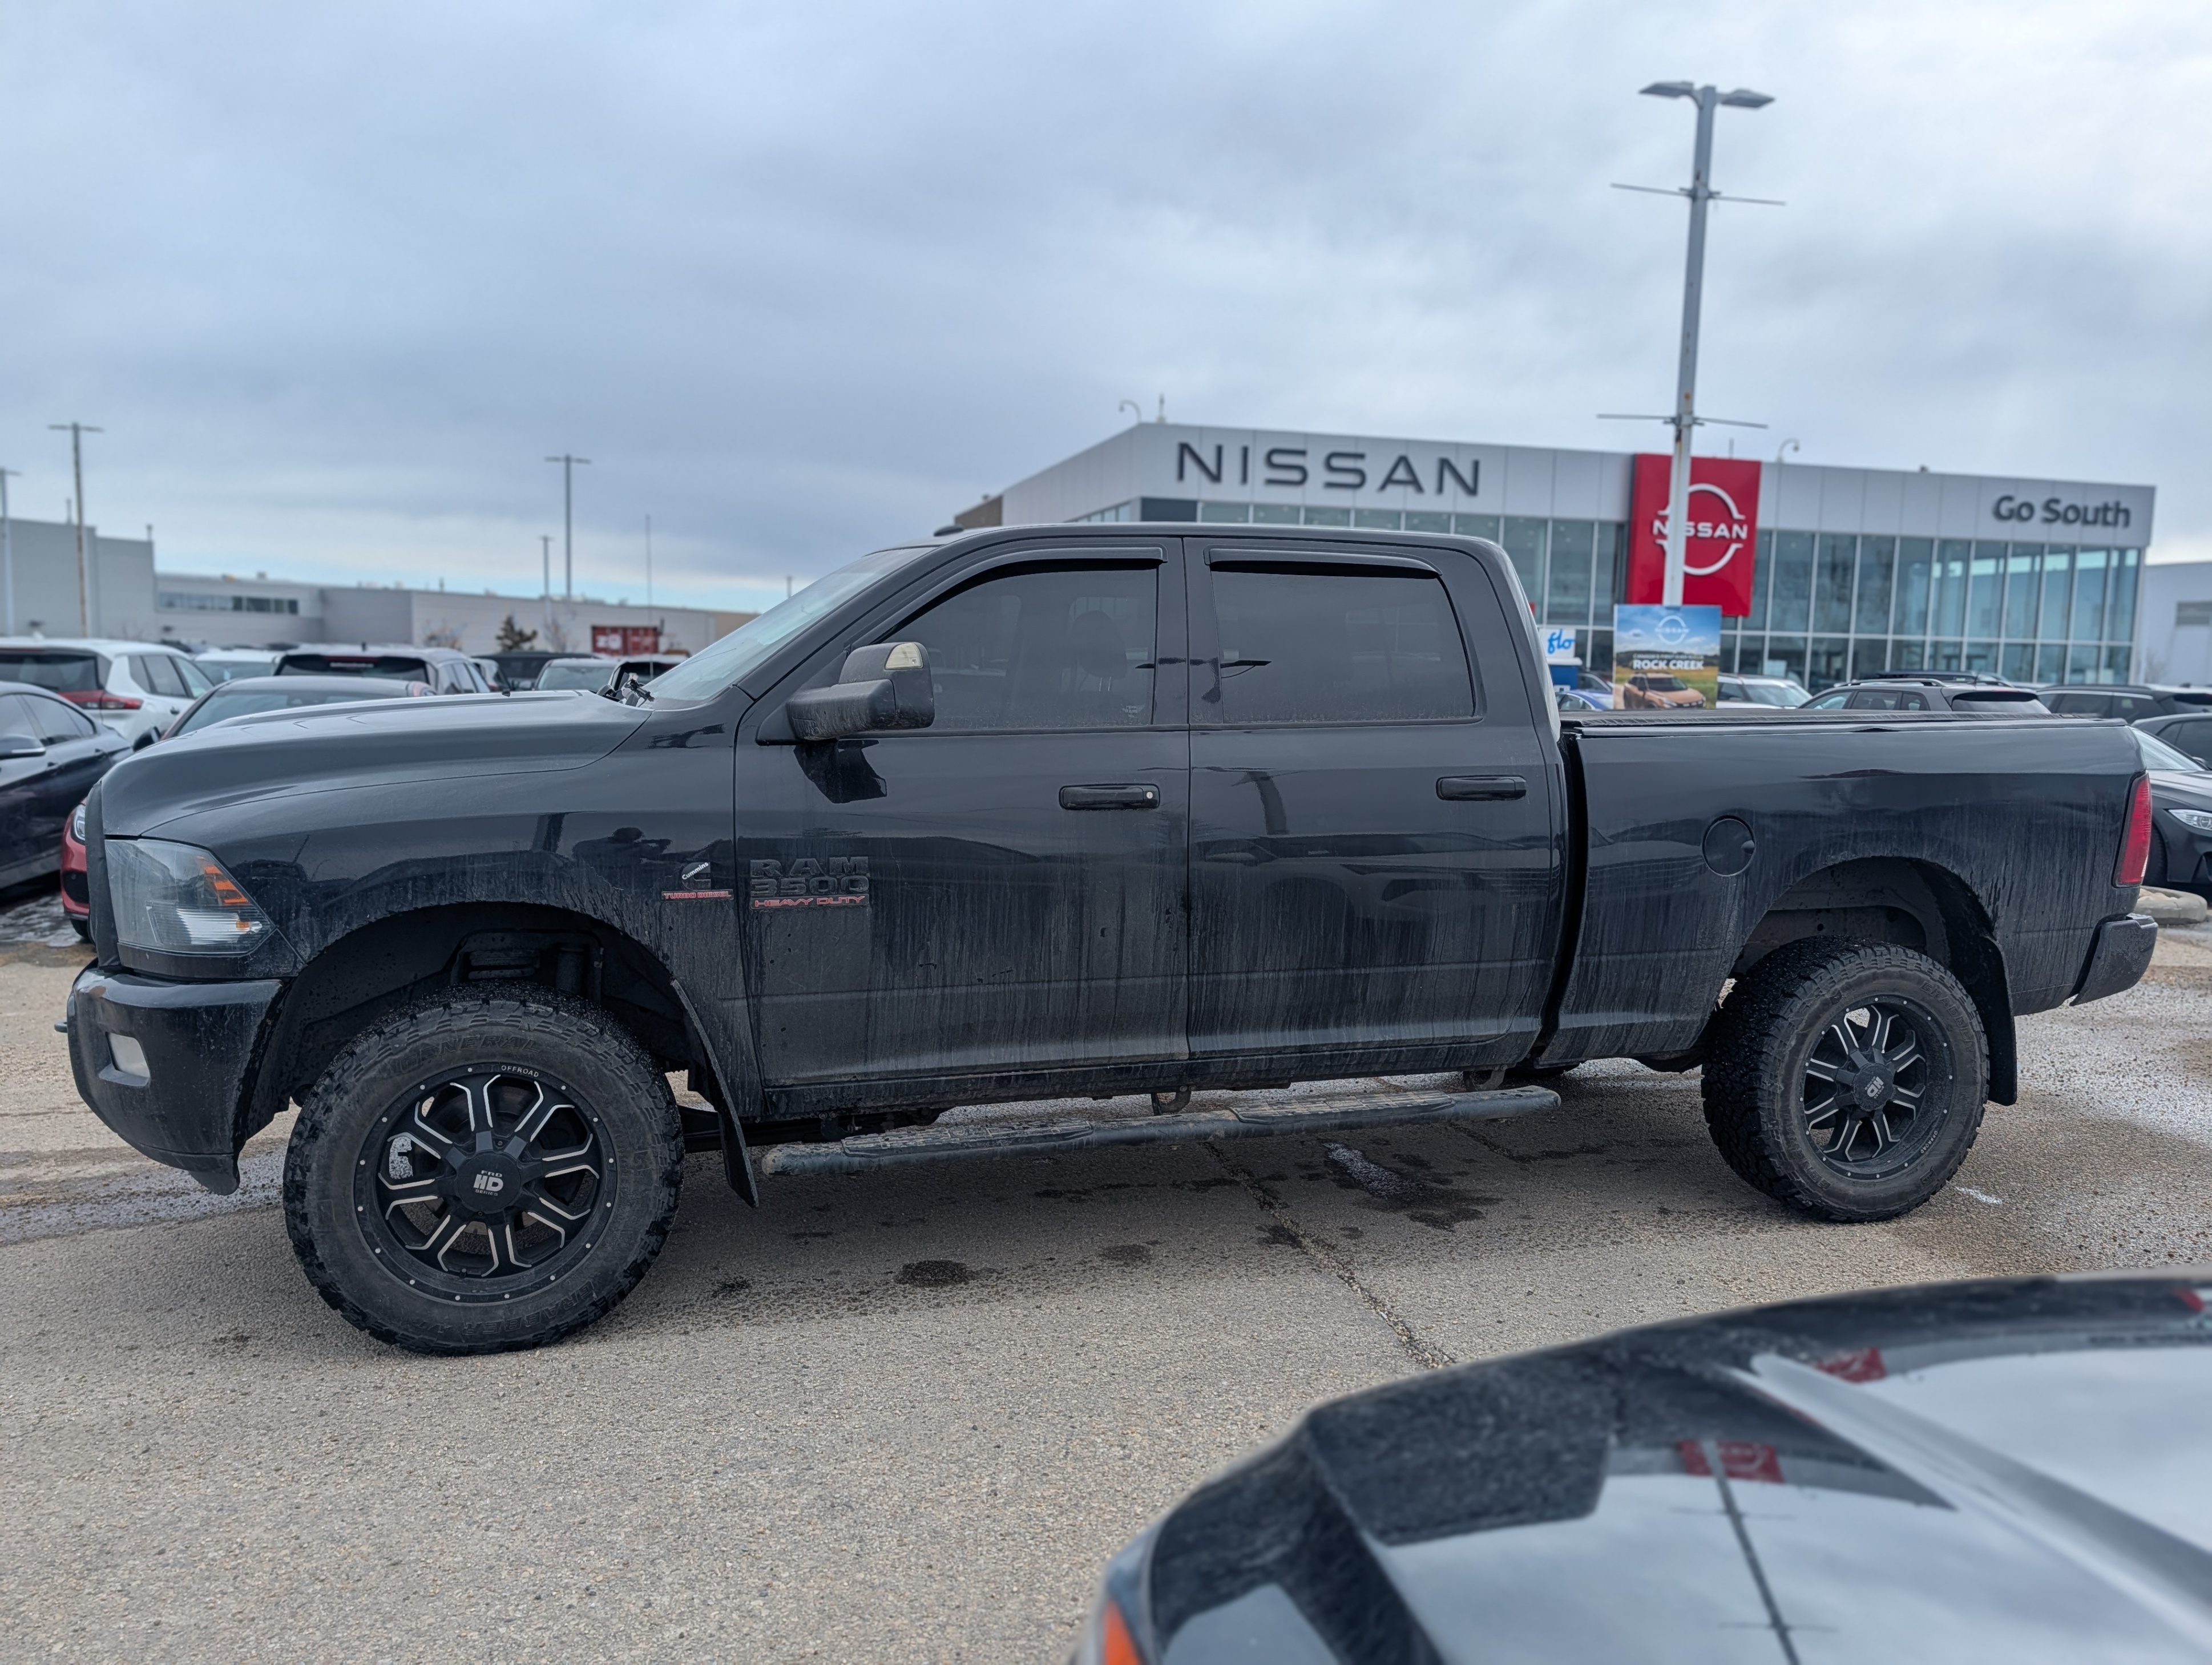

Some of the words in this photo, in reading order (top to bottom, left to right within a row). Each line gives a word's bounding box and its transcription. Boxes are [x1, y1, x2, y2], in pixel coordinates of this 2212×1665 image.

[1177, 442, 1480, 497] NISSAN
[1992, 495, 2035, 523] Go
[2040, 497, 2131, 528] South
[1652, 519, 1748, 540] NSSAN
[1547, 628, 1576, 654] flo
[1633, 659, 1668, 670] ROCK
[1669, 659, 1705, 670] CREEK
[682, 862, 709, 880] Cummins
[750, 856, 870, 877] RAM
[750, 876, 869, 896] 3500
[754, 898, 814, 907] HEAVY
[817, 896, 865, 905] DUTY
[501, 1065, 539, 1077] OFFROAD
[1867, 1076, 1884, 1097] HD
[473, 1174, 503, 1192] HD
